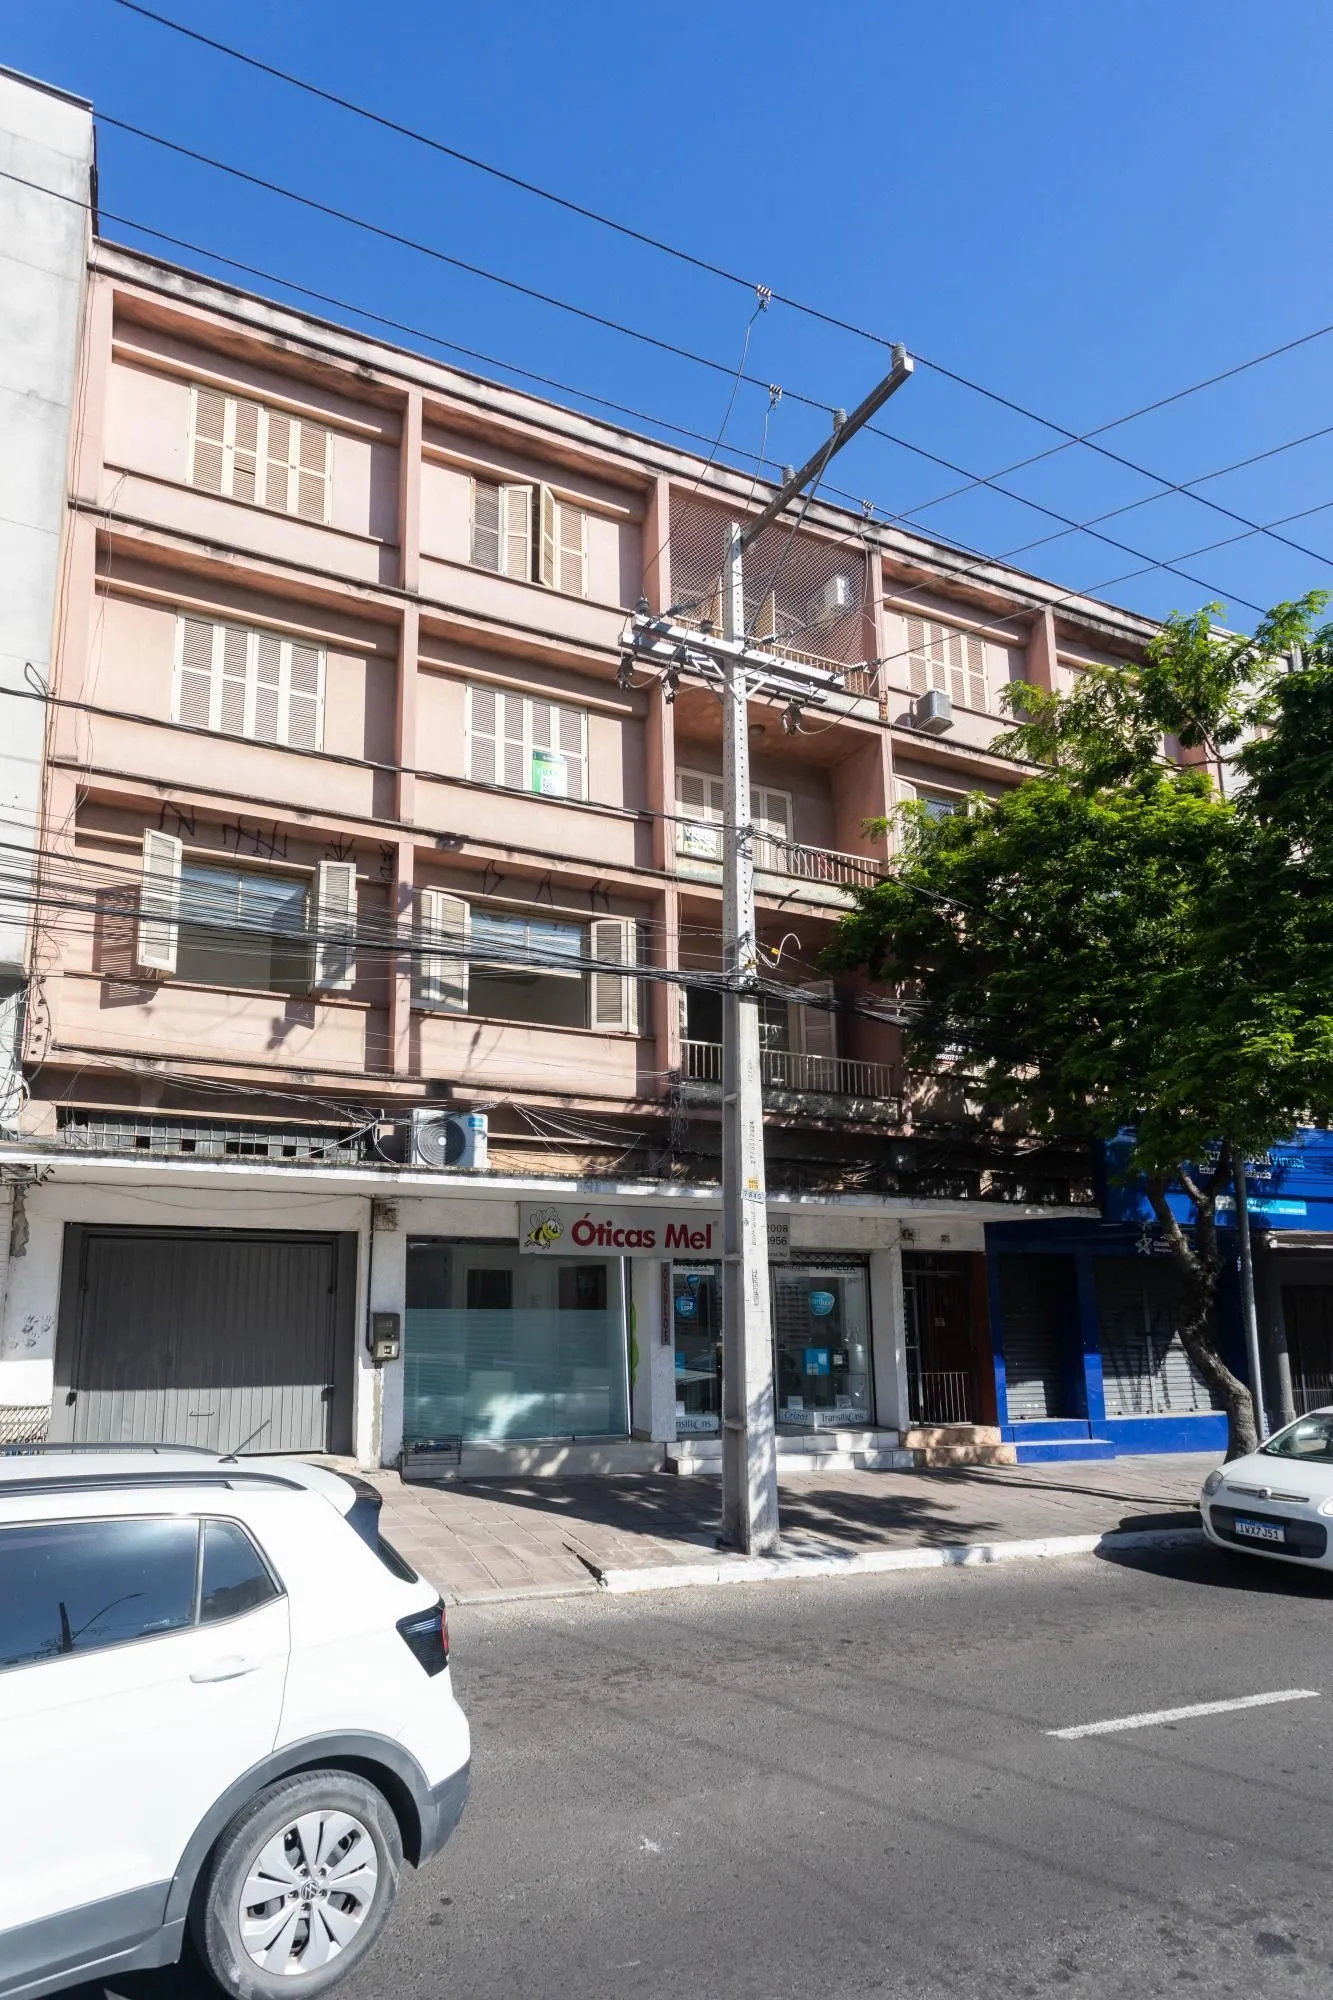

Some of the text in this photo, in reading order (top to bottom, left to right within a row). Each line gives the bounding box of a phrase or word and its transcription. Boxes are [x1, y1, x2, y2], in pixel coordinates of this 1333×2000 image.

[571, 1212, 712, 1249] Óticas Mel
[767, 1236, 788, 1245] 956
